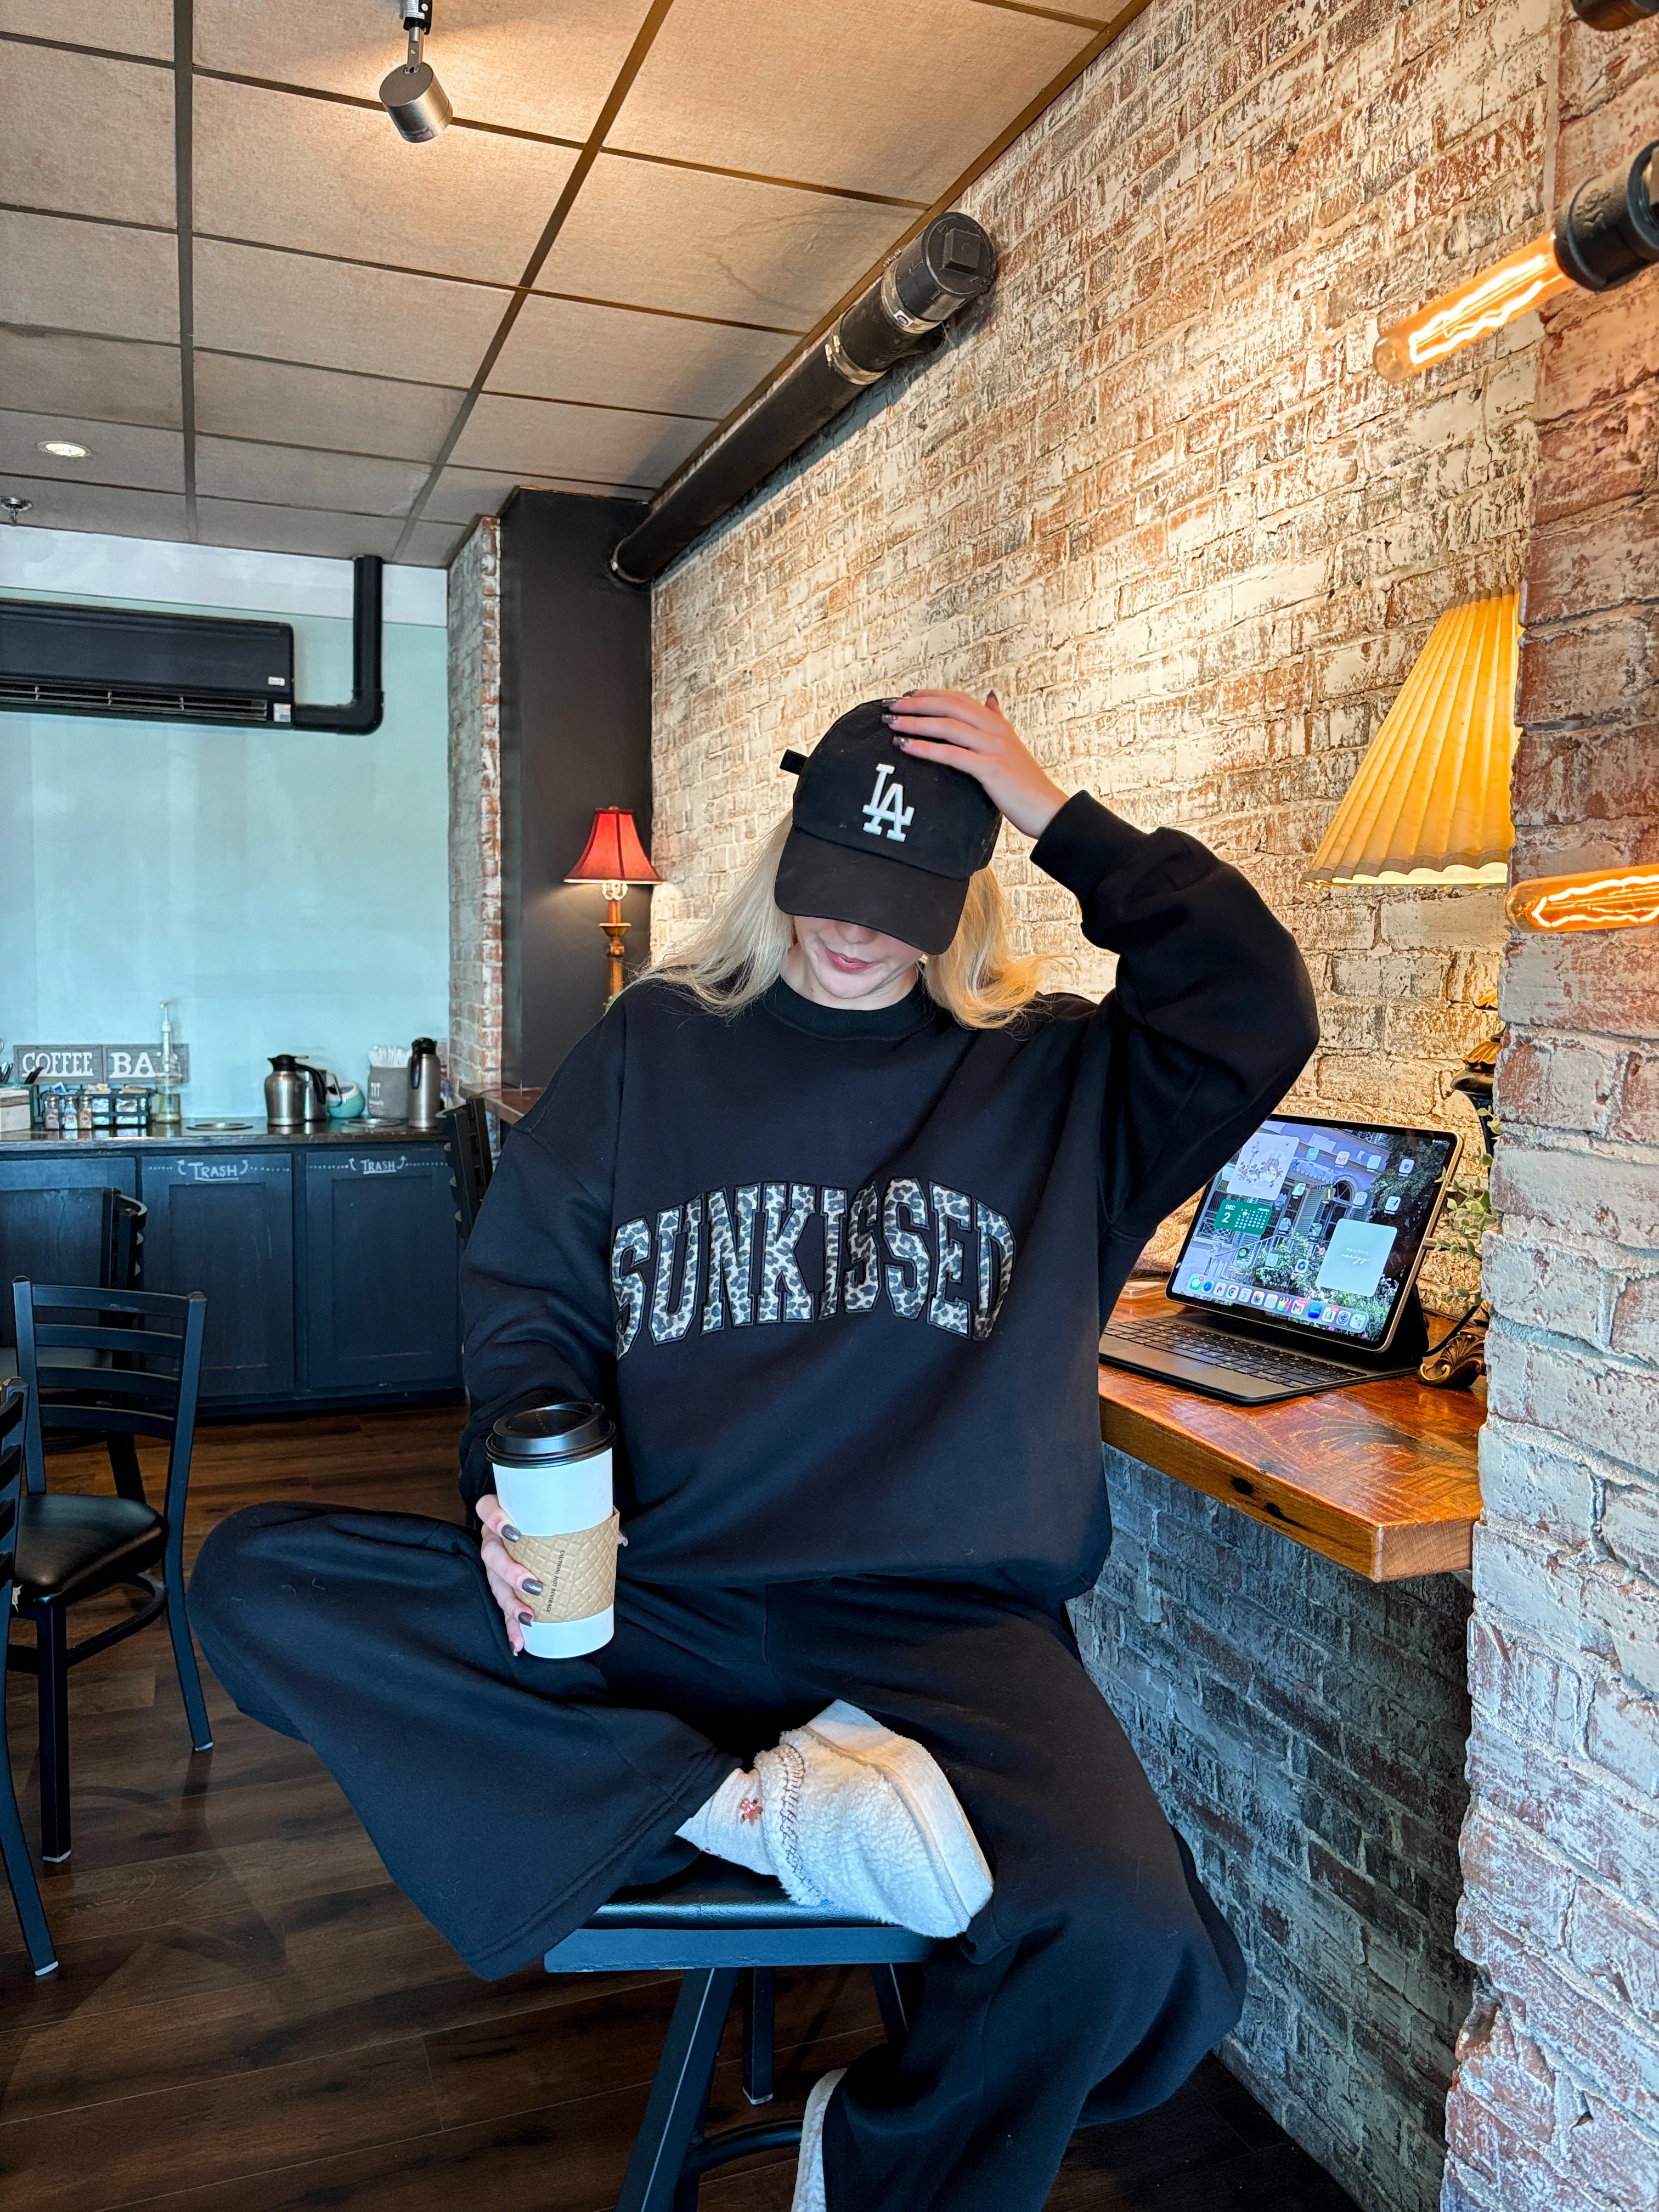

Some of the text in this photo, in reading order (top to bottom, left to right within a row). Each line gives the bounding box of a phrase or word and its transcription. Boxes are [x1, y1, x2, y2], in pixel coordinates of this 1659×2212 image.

[862, 764, 915, 842] LA
[21, 1051, 94, 1077] COFFEE
[188, 1161, 239, 1181] TRASH
[360, 1159, 396, 1174] TRASH
[1222, 1211, 1231, 1223] 2
[611, 1177, 1017, 1361] SUNKISSED
[546, 1588, 556, 1613] BEVERAGE
